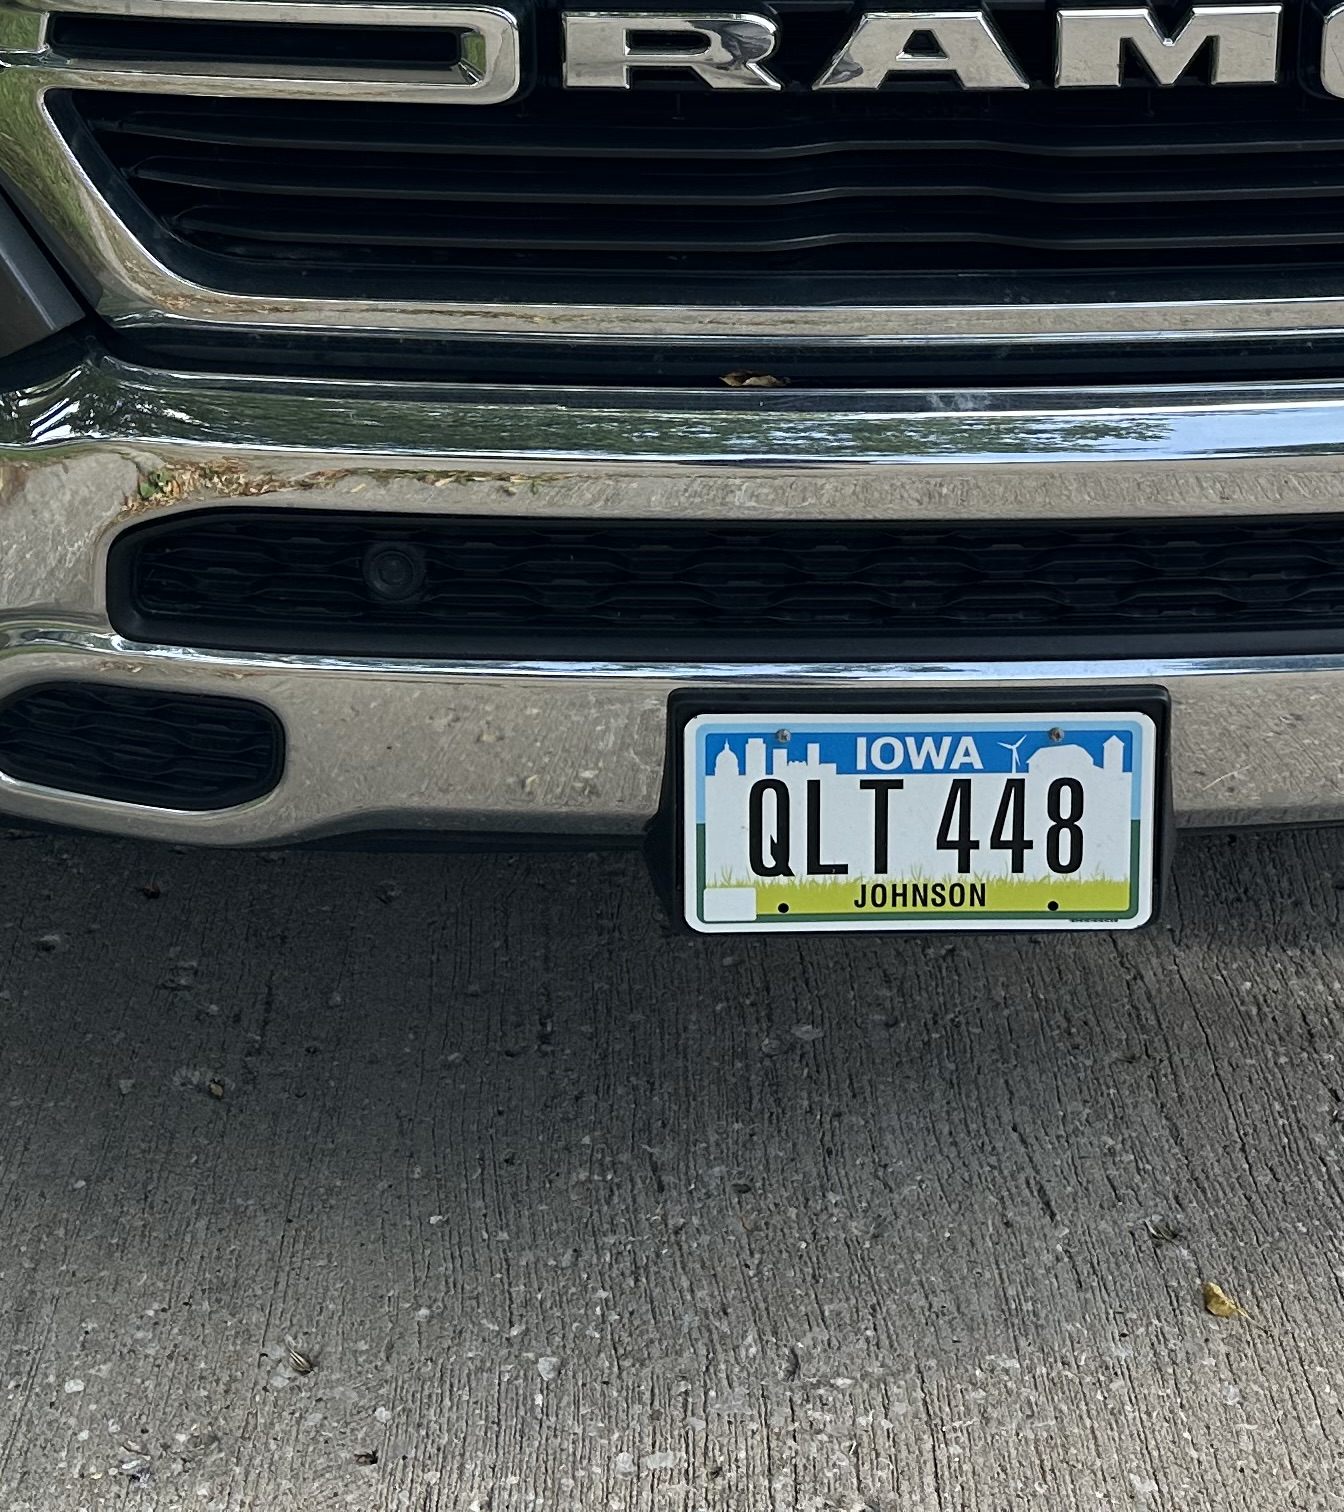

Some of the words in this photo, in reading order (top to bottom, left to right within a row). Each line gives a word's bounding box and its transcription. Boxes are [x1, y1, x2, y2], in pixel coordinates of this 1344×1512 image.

[562, 4, 1283, 90] RAM
[856, 736, 984, 771] IOWA
[748, 778, 904, 877] QLT
[936, 777, 1085, 874] 448
[853, 882, 987, 909] JOHNSON
